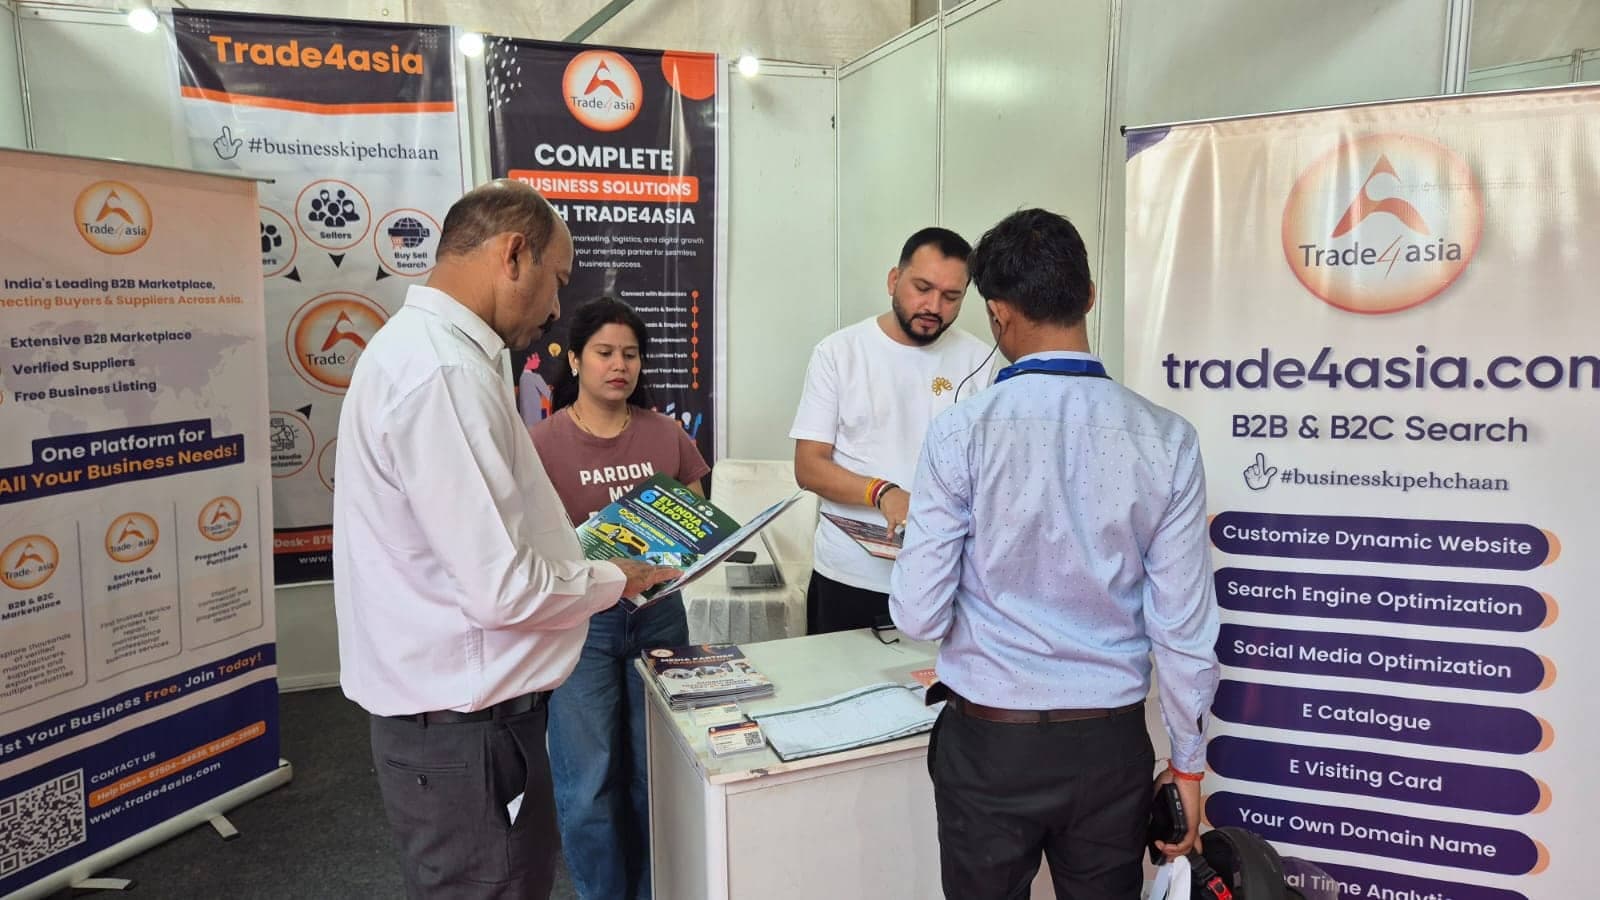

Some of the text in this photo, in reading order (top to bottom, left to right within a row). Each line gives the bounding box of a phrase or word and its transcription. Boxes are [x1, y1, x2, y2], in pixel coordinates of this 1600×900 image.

[209, 35, 424, 75] Trade4asia
[248, 138, 439, 161] #businesskipehchaan
[534, 143, 674, 171] COMPLETE
[602, 181, 692, 197] SOLUTIONS
[573, 205, 695, 225] TRADE4ASIA
[320, 231, 352, 240] Sellers
[394, 252, 428, 260] Buy Sell
[396, 260, 427, 269] Search
[5, 277, 216, 292] India's Leading B2B Marketplace,
[55, 296, 104, 309] Buyers
[116, 295, 175, 308] Suppliers
[178, 295, 217, 305] Across
[10, 331, 192, 348] Extensive B2B Marketplace
[13, 357, 136, 376] Verified Suppliers
[15, 381, 157, 402] Free Business Listing
[1232, 415, 1528, 443] B2B & B2C Search
[41, 428, 206, 463] One Platform for
[0, 443, 239, 495] All Your Business Needs!
[579, 461, 655, 486] PARDON
[1280, 468, 1510, 493] #businesskipehchaan
[651, 500, 680, 520] EXPO
[679, 518, 707, 539] 2026
[661, 496, 675, 508] EV
[672, 504, 702, 526] INDIA
[1223, 525, 1533, 556] Customize Dynamic Website
[1227, 580, 1523, 616] Search Engine Optimization
[1233, 639, 1512, 679] Social Media Optimization
[27, 723, 66, 745] Your
[70, 696, 141, 730] Business
[144, 682, 182, 703] Free,
[184, 670, 215, 688] Join
[217, 652, 263, 676] Today!
[1302, 703, 1432, 732] E Catalogue
[91, 750, 157, 784] CONTACT US
[1289, 759, 1443, 792] E Visiting Card
[89, 761, 222, 826] www.trade4asia.com
[1238, 807, 1497, 857] Your Own Domain Name
